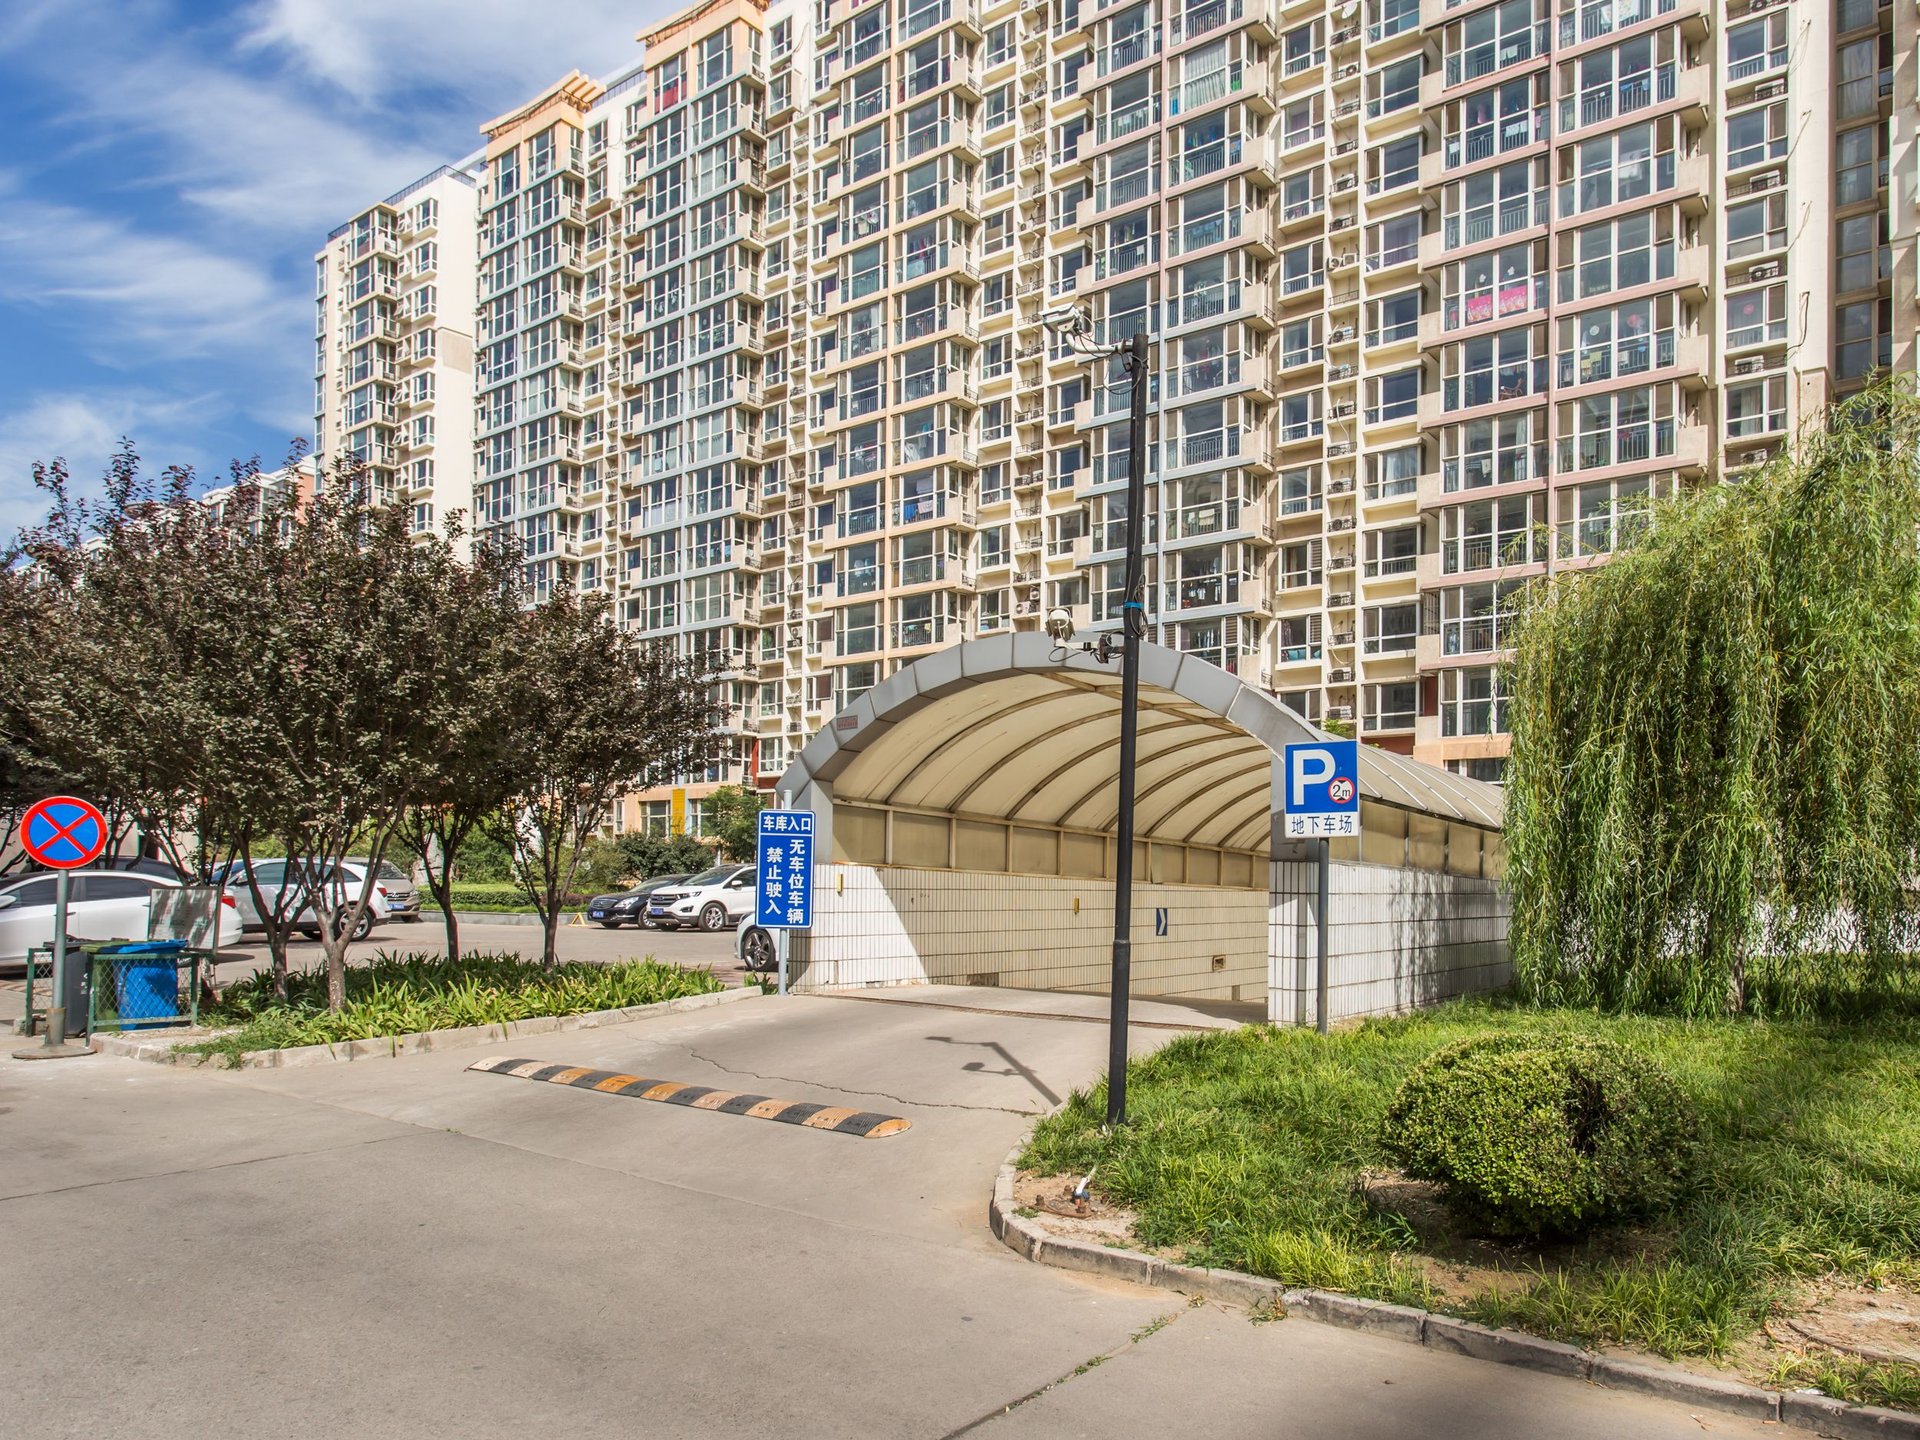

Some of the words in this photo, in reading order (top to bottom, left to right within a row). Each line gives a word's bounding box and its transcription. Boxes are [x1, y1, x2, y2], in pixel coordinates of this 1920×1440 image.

[1293, 749, 1336, 805] P
[1332, 784, 1351, 797] 2m
[763, 815, 811, 831] 车库入口
[1291, 815, 1352, 834] 地下车场
[765, 847, 783, 915] 禁止驶入
[787, 839, 805, 924] 无车位车辆
